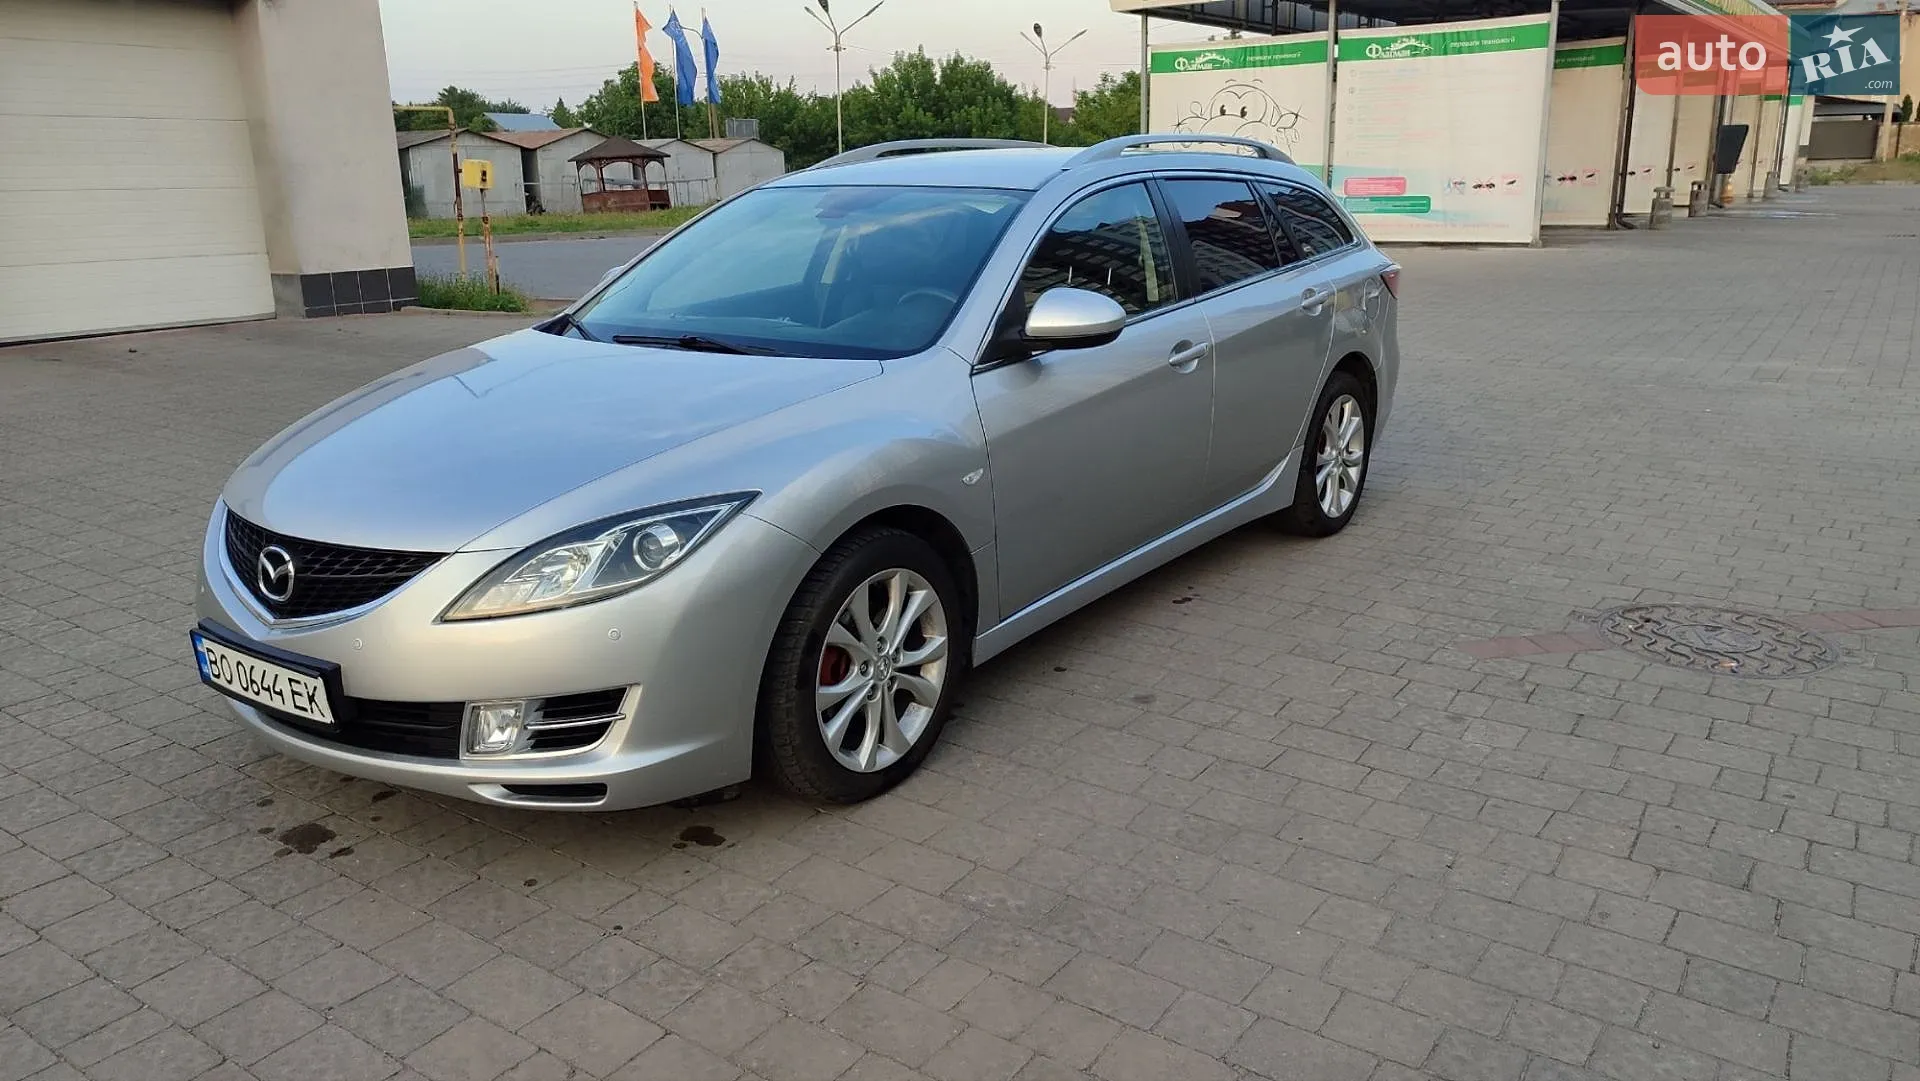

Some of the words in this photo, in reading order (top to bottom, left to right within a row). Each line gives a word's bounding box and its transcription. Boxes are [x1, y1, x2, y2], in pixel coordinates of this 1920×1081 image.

[206, 647, 233, 685] BO
[236, 660, 286, 705] 0644
[288, 677, 325, 717] EK
